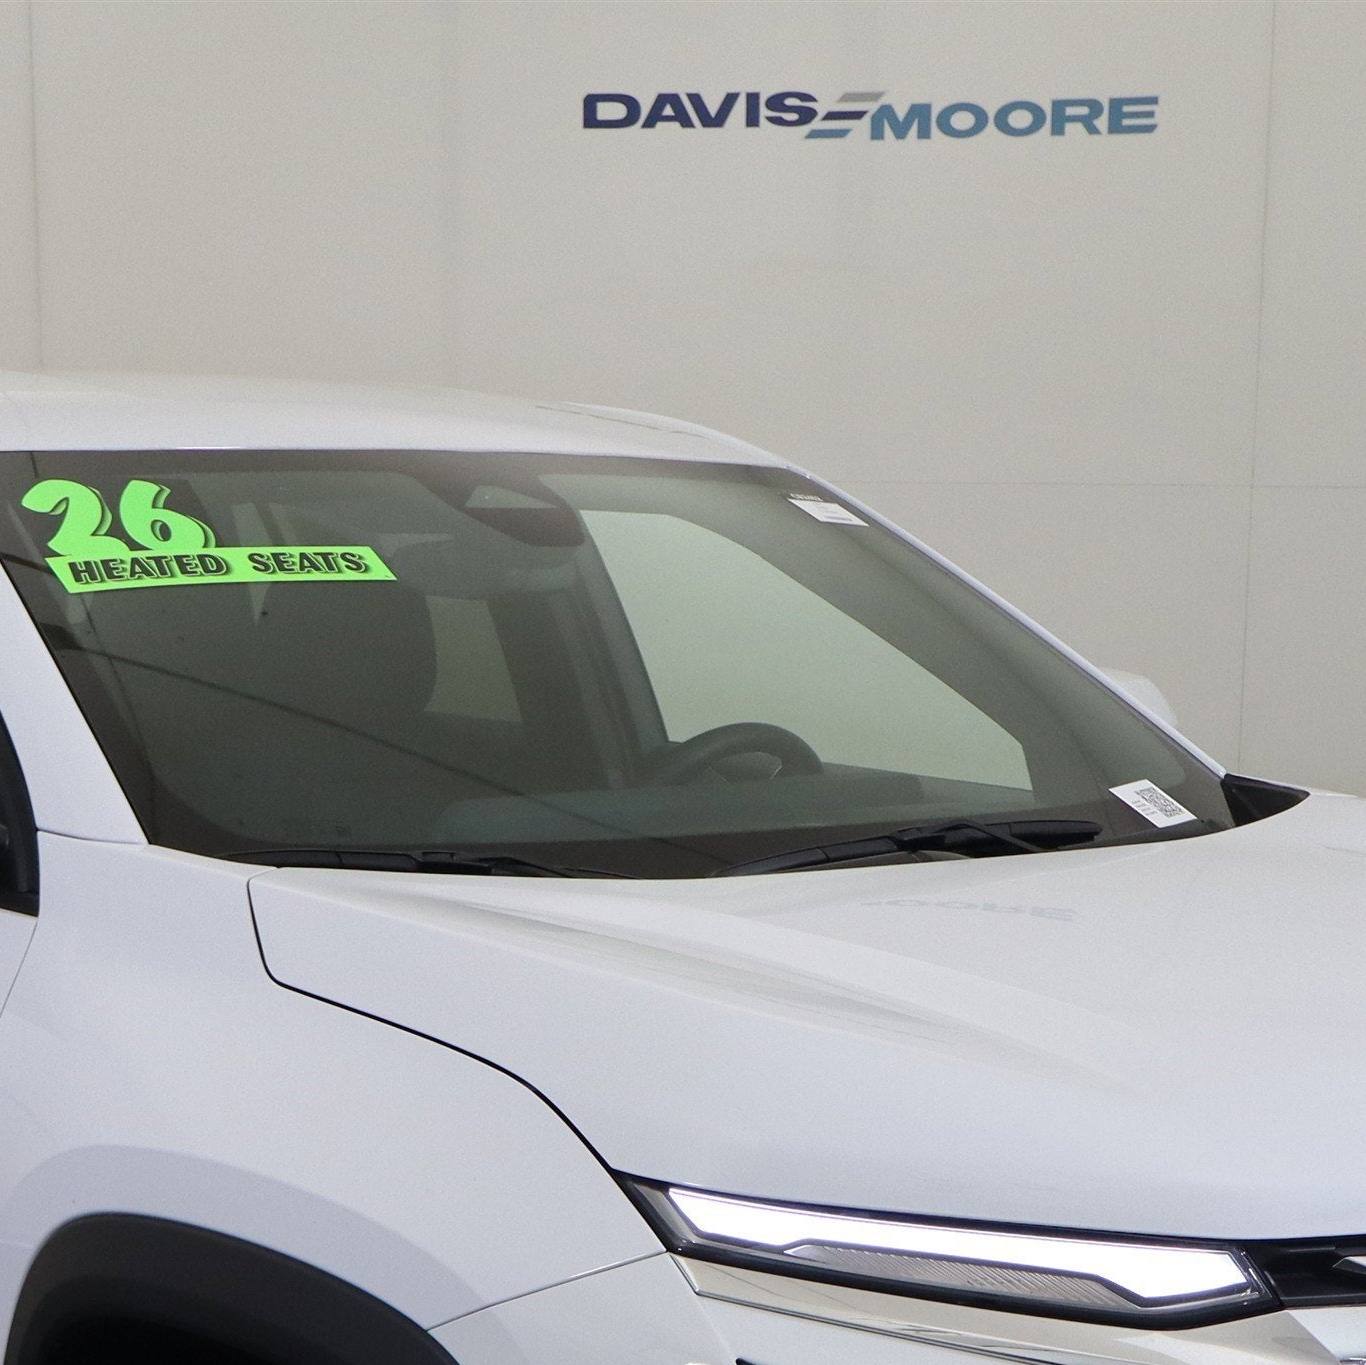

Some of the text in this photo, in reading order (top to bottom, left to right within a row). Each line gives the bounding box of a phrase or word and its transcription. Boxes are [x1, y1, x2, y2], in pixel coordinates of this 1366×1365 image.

[582, 90, 1160, 141] DAVIS MOORE
[21, 479, 215, 557] 26
[68, 551, 370, 585] HEATED SEATS
